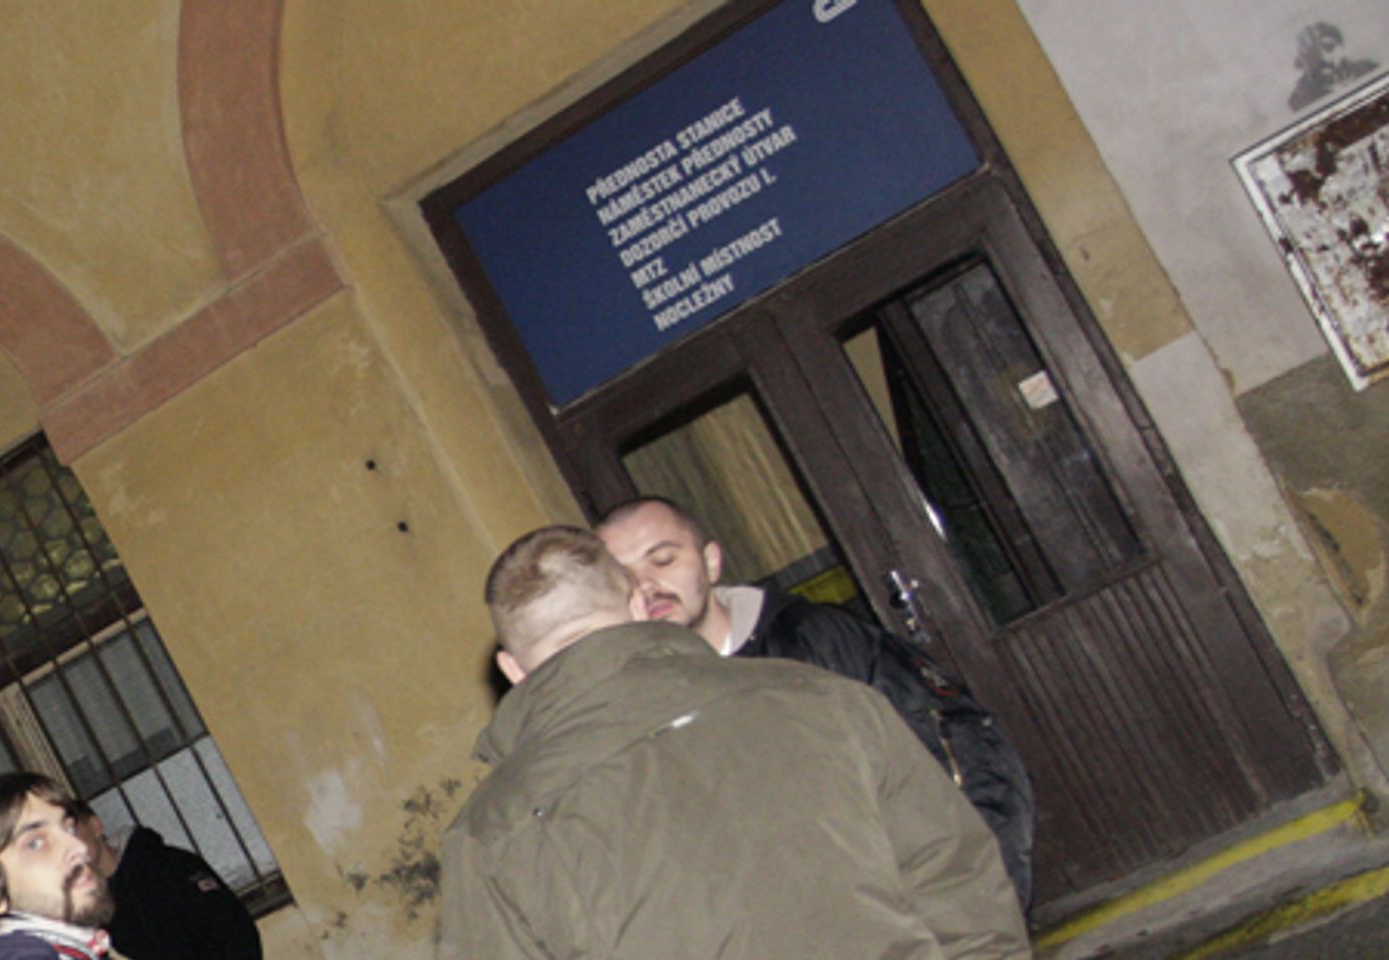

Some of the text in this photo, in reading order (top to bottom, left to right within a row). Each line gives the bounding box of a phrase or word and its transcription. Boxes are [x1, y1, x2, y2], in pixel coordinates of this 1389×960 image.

[676, 97, 745, 150] STANICE
[687, 172, 761, 228] PROVOZU
[630, 256, 668, 289] MTZ
